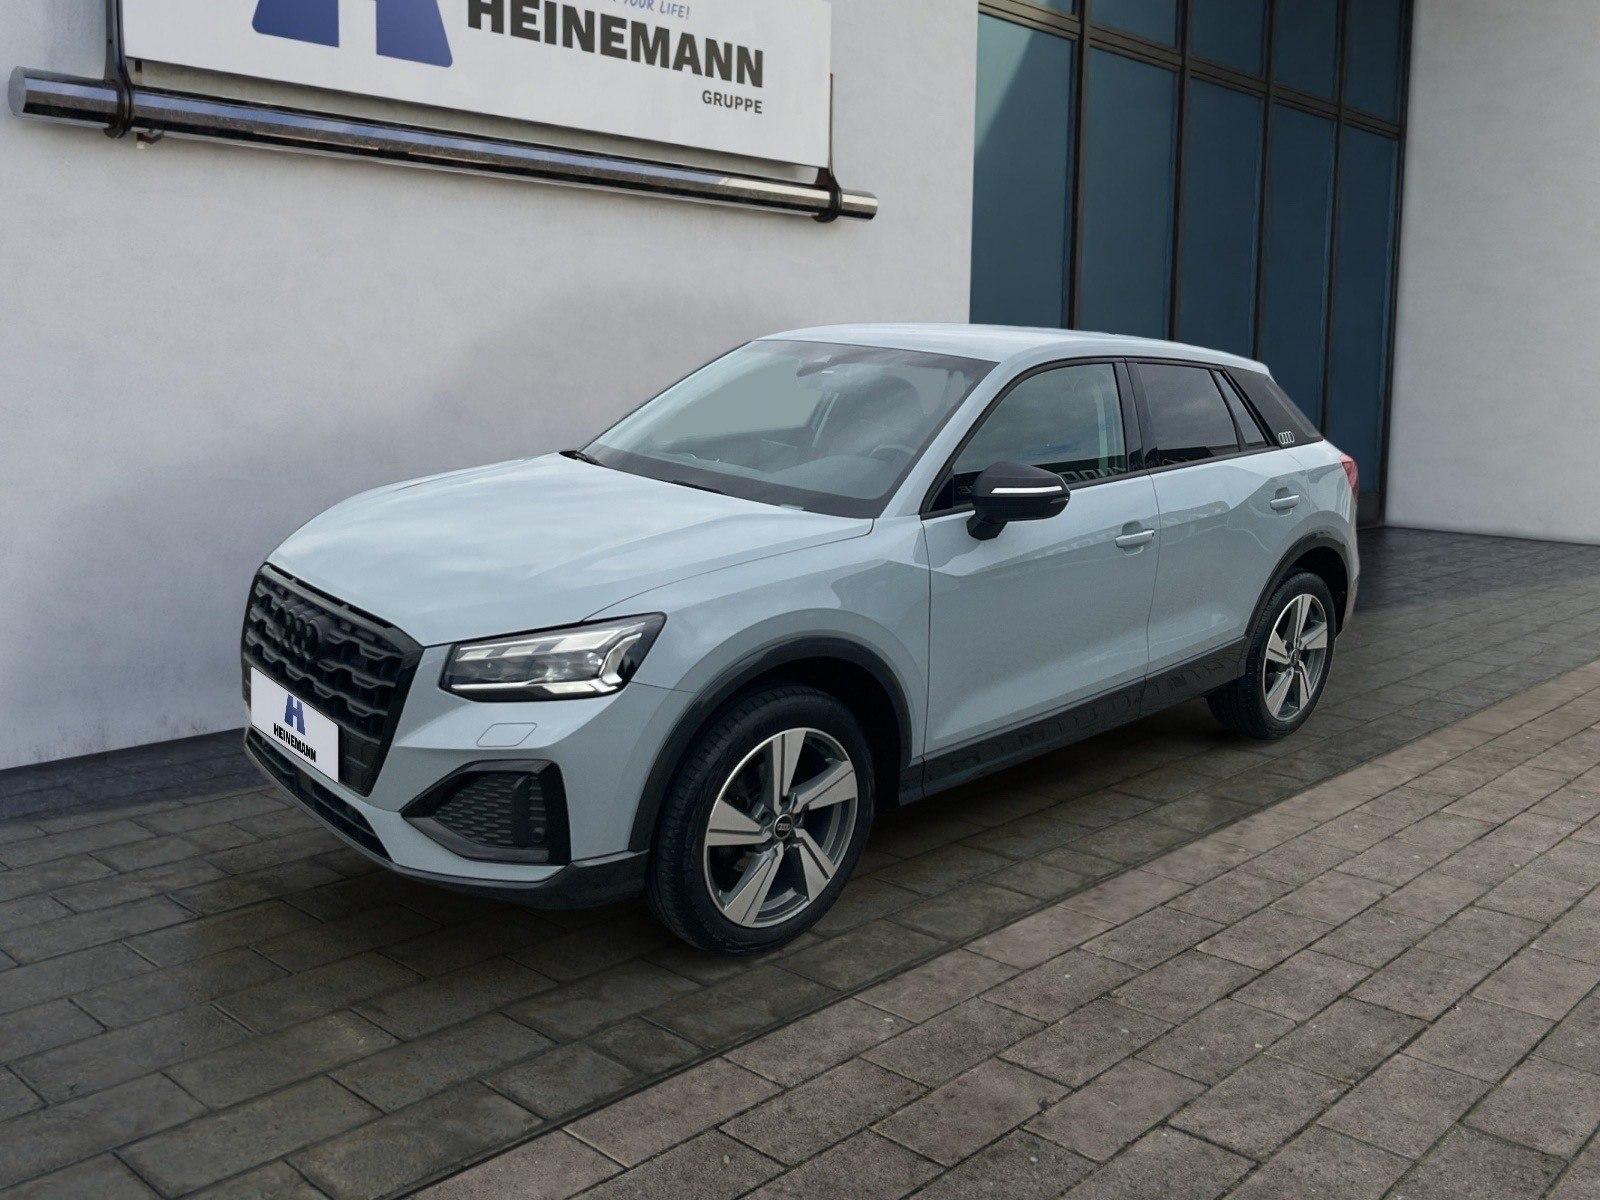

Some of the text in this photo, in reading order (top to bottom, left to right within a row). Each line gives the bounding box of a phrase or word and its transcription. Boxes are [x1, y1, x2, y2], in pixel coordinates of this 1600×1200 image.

[660, 1, 690, 19] LIFE!
[468, 0, 763, 87] HEINEMANN
[702, 90, 762, 114] GRUPPE
[273, 722, 317, 762] HEINEMANN
